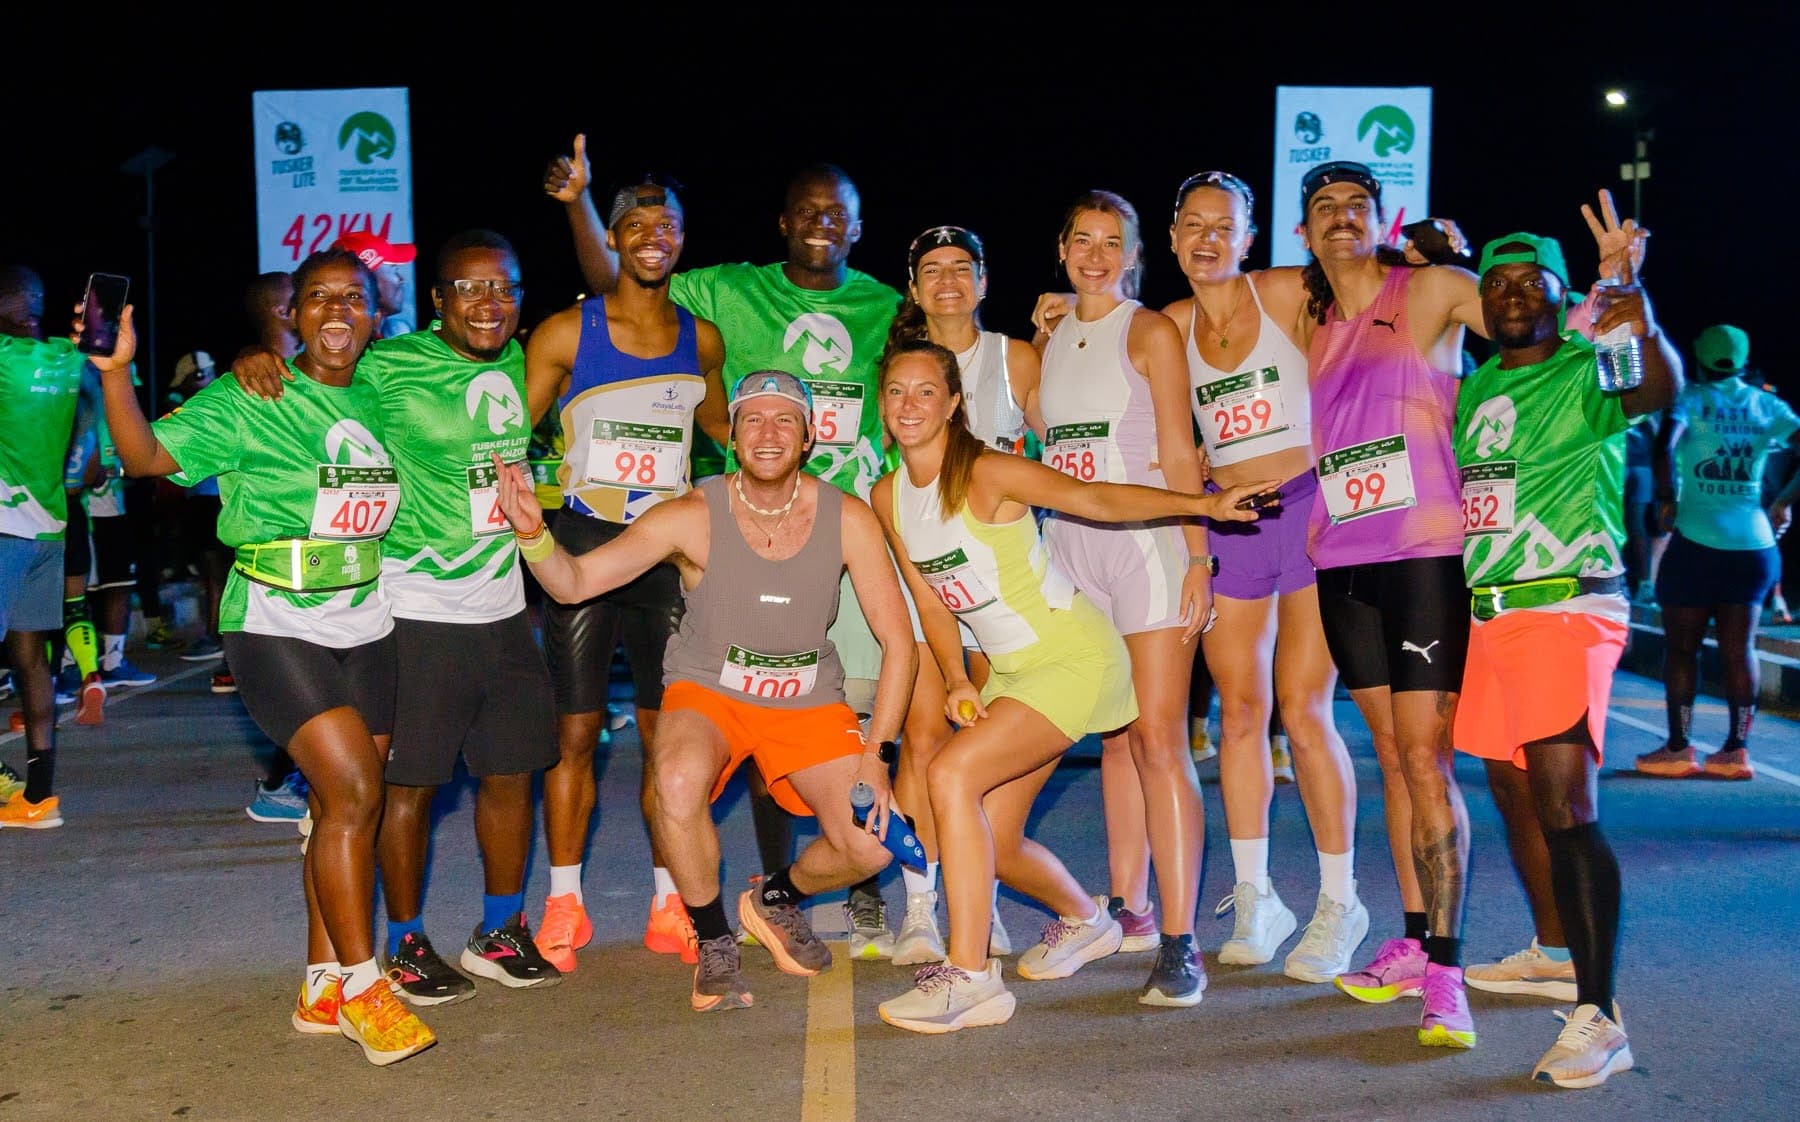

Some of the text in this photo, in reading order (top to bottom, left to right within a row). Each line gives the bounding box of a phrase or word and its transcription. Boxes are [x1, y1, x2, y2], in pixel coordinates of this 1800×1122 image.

[272, 156, 313, 175] TUSKER
[1289, 147, 1330, 163] TUSKER
[293, 172, 316, 188] LITE
[812, 410, 837, 440] 5
[1215, 400, 1271, 440] 259
[471, 437, 528, 451] TUSKER LITE
[615, 452, 656, 484] 98
[1345, 473, 1385, 511] 99
[330, 500, 387, 533] 407
[933, 580, 976, 609] 61
[743, 675, 801, 698] 100
